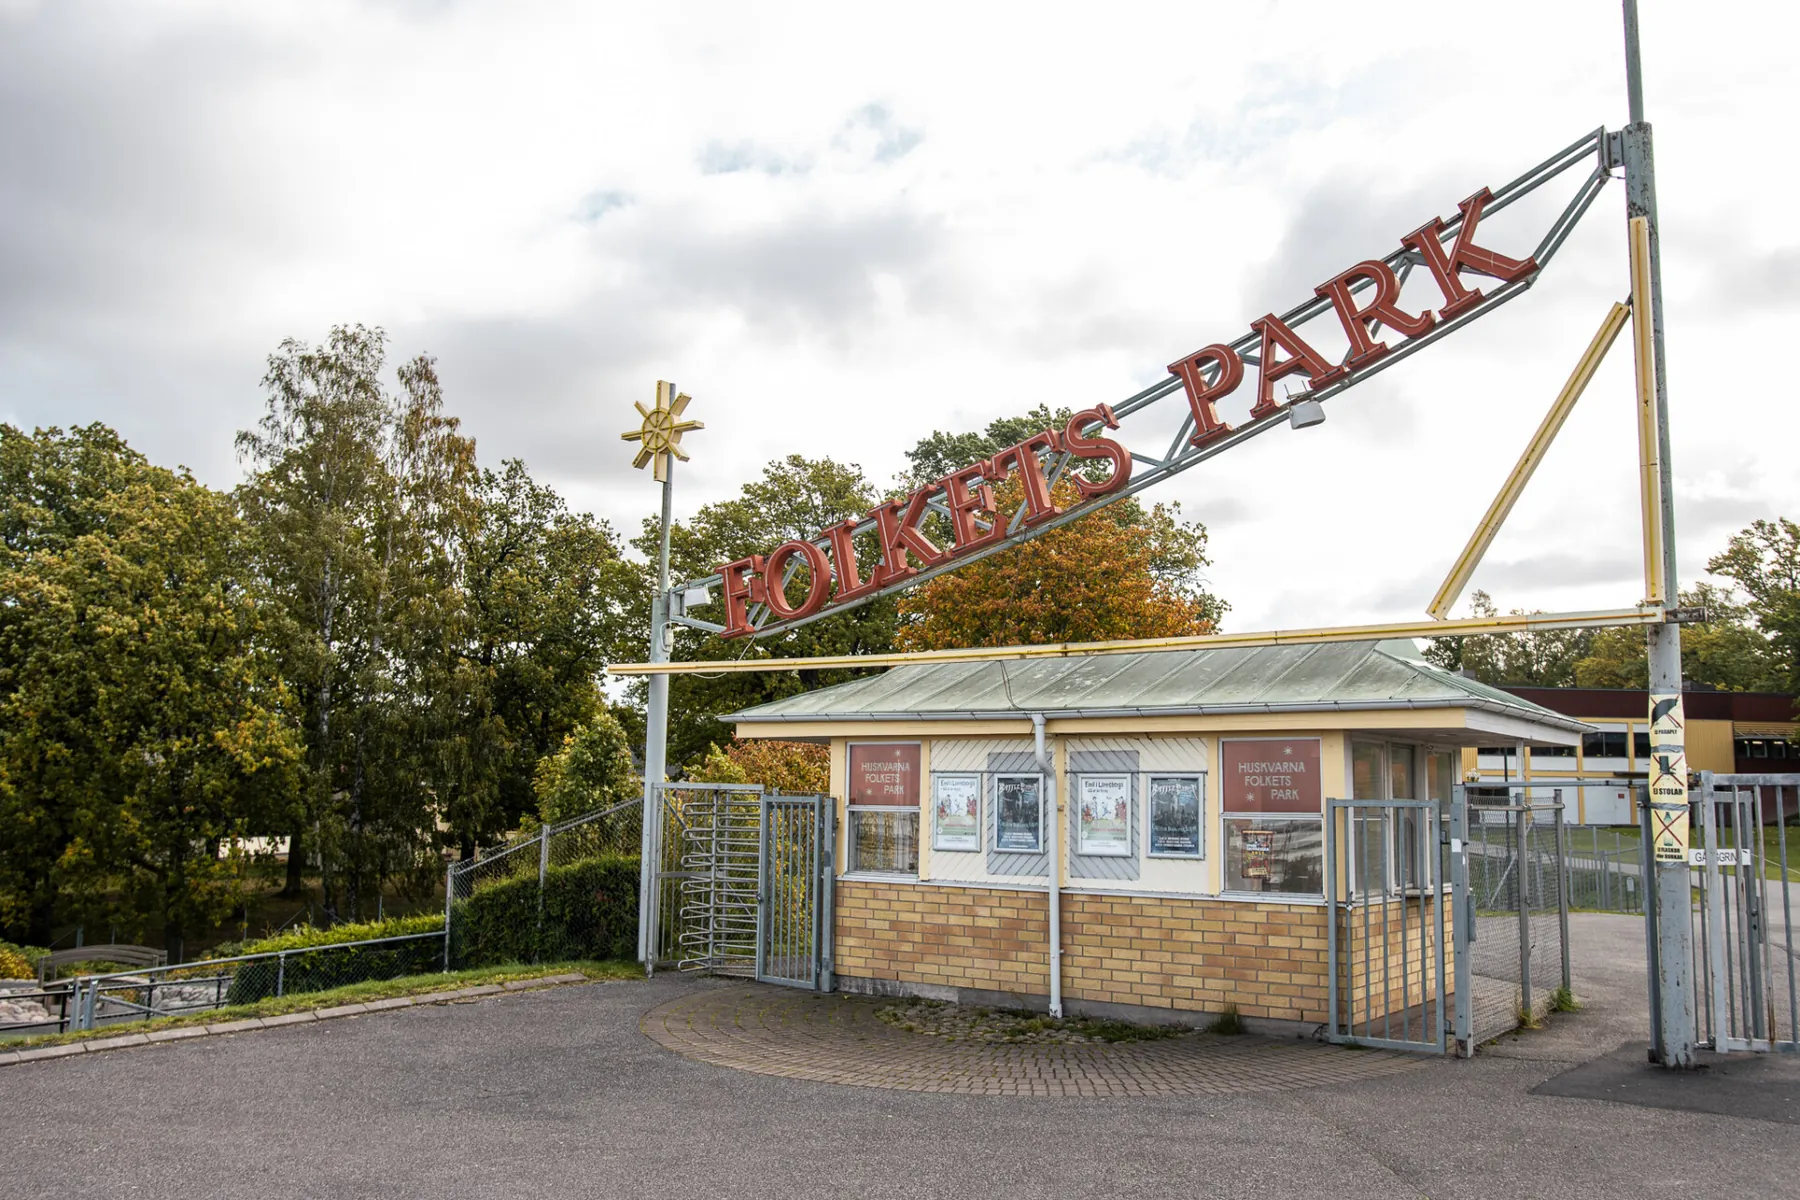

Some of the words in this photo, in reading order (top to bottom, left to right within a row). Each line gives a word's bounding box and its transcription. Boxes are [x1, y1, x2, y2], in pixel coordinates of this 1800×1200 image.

[715, 403, 1132, 639] FOLKETS
[1167, 186, 1540, 449] PARK
[861, 762, 910, 773] HUSKVARNA
[1238, 762, 1306, 773] HUSKVARNA
[865, 773, 900, 783] FOLKETS
[1245, 775, 1292, 786] FOLKETS
[884, 785, 905, 795] PARK
[1271, 788, 1300, 800] PARK
